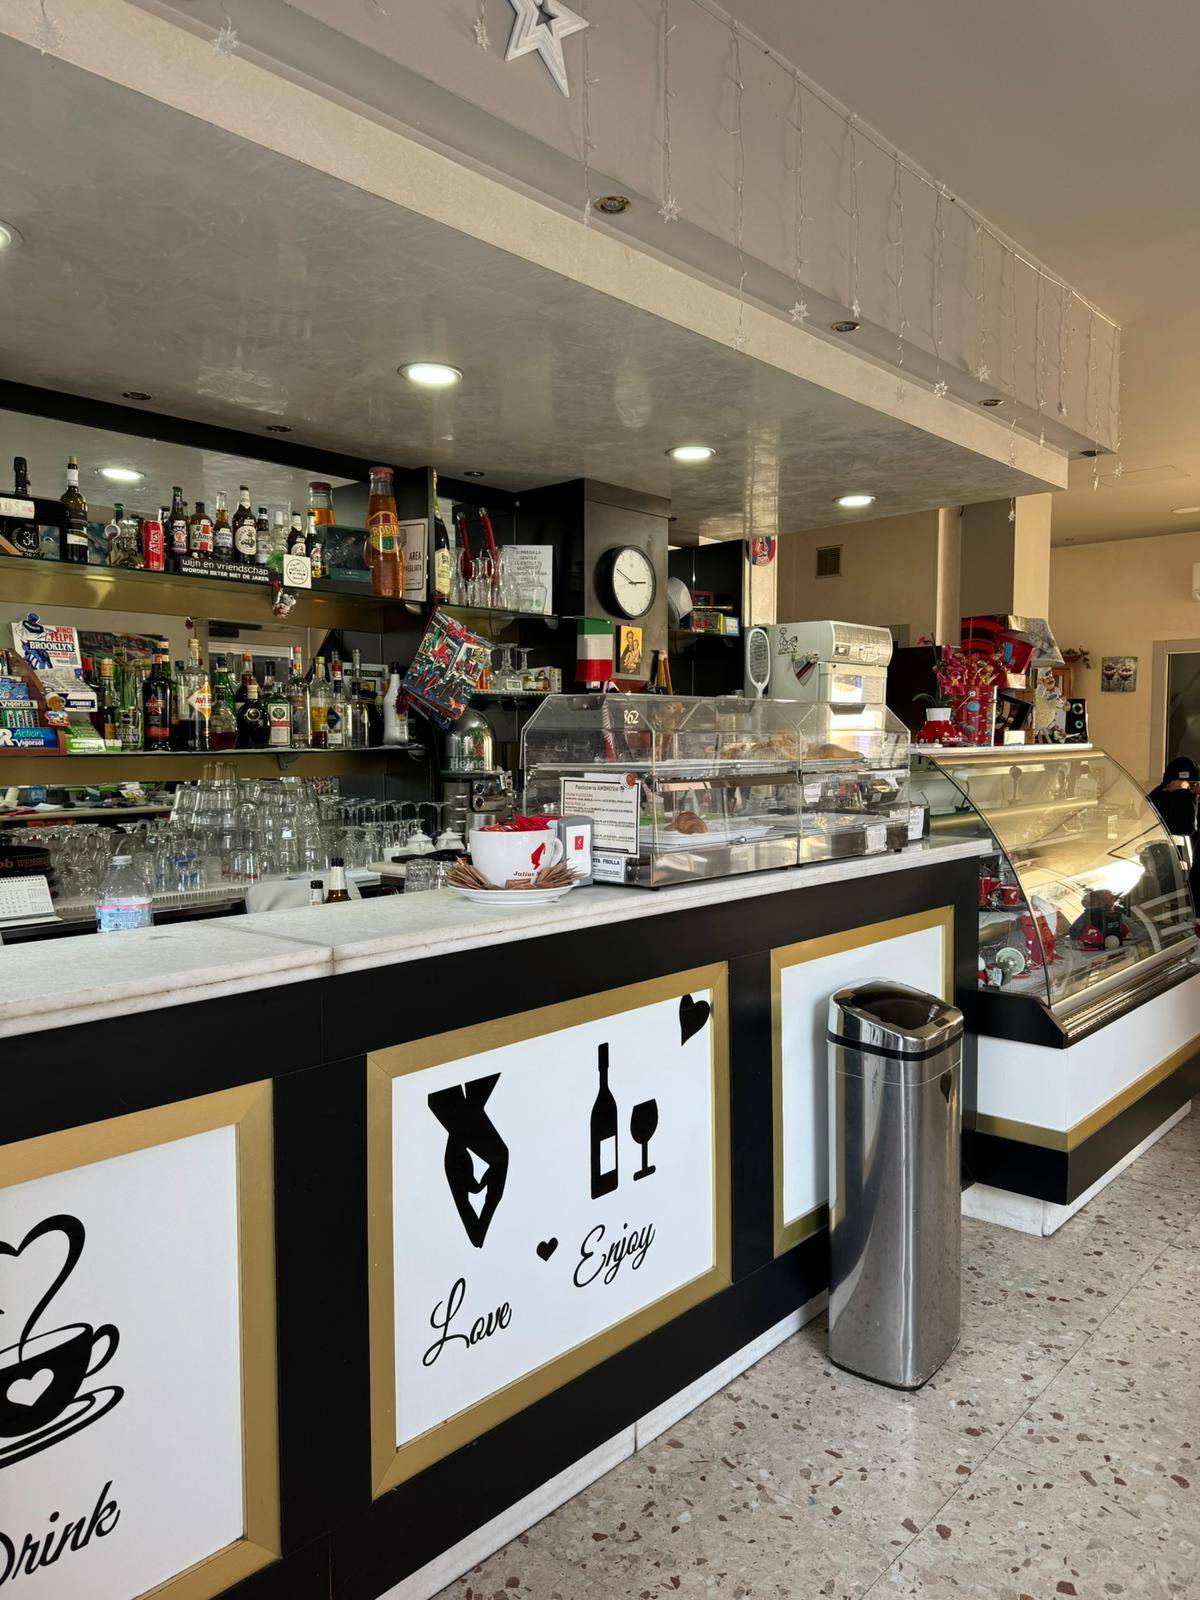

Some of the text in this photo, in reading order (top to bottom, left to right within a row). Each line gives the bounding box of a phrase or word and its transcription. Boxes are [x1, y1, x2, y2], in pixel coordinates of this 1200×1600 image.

[371, 524, 400, 536] RODIN
[409, 551, 421, 560] AREA
[203, 560, 214, 568] en
[182, 567, 208, 575] WORDEN
[29, 641, 73, 651] BROOKLYN
[14, 729, 44, 738] Action
[572, 1222, 656, 1288] Enjoy
[422, 1277, 513, 1367] Love
